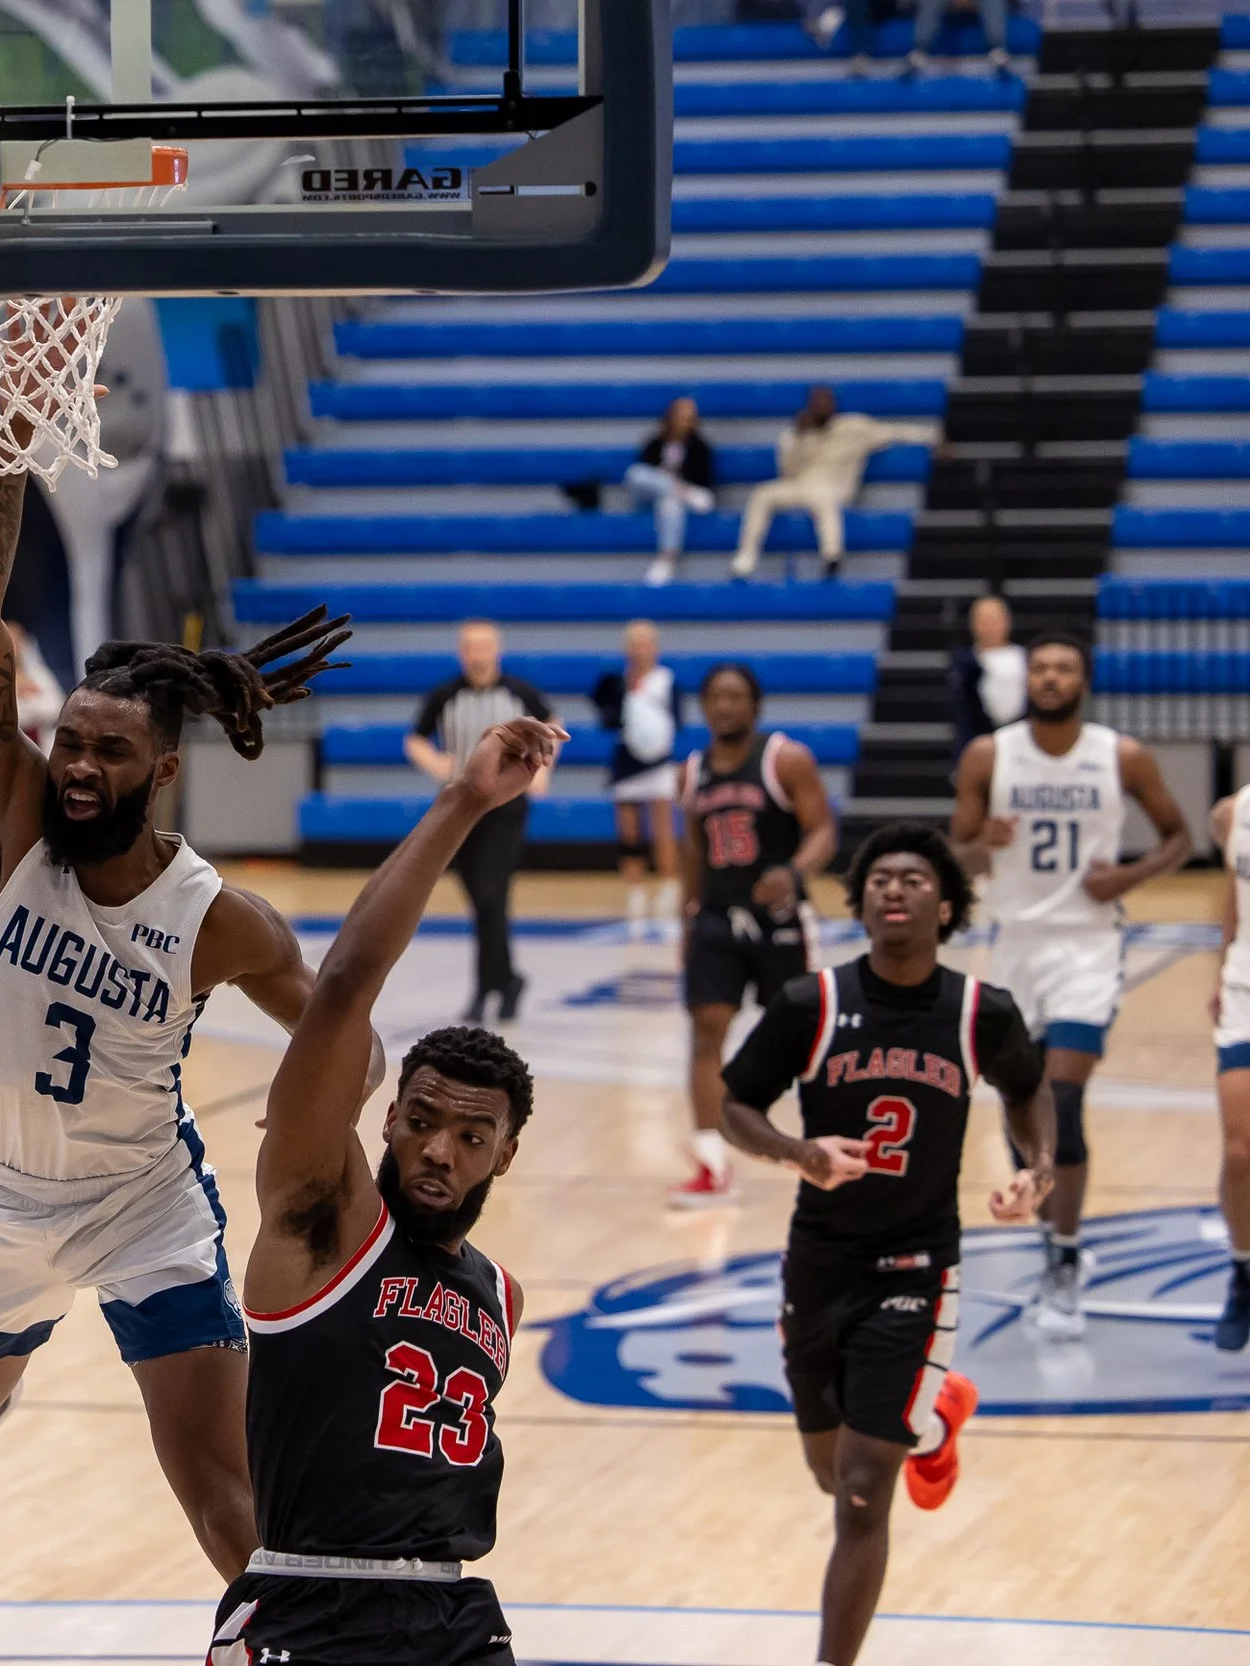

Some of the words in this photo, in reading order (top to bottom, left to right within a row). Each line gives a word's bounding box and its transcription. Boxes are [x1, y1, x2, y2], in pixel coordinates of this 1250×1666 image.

[705, 812, 759, 870] 15
[1030, 819, 1081, 873] 21
[130, 923, 180, 955] PBC
[34, 1001, 97, 1106] 3
[826, 1047, 961, 1098] FLAGLER
[862, 1095, 918, 1177] 2
[372, 1276, 508, 1383] FLAGLER
[373, 1340, 490, 1467] 23
